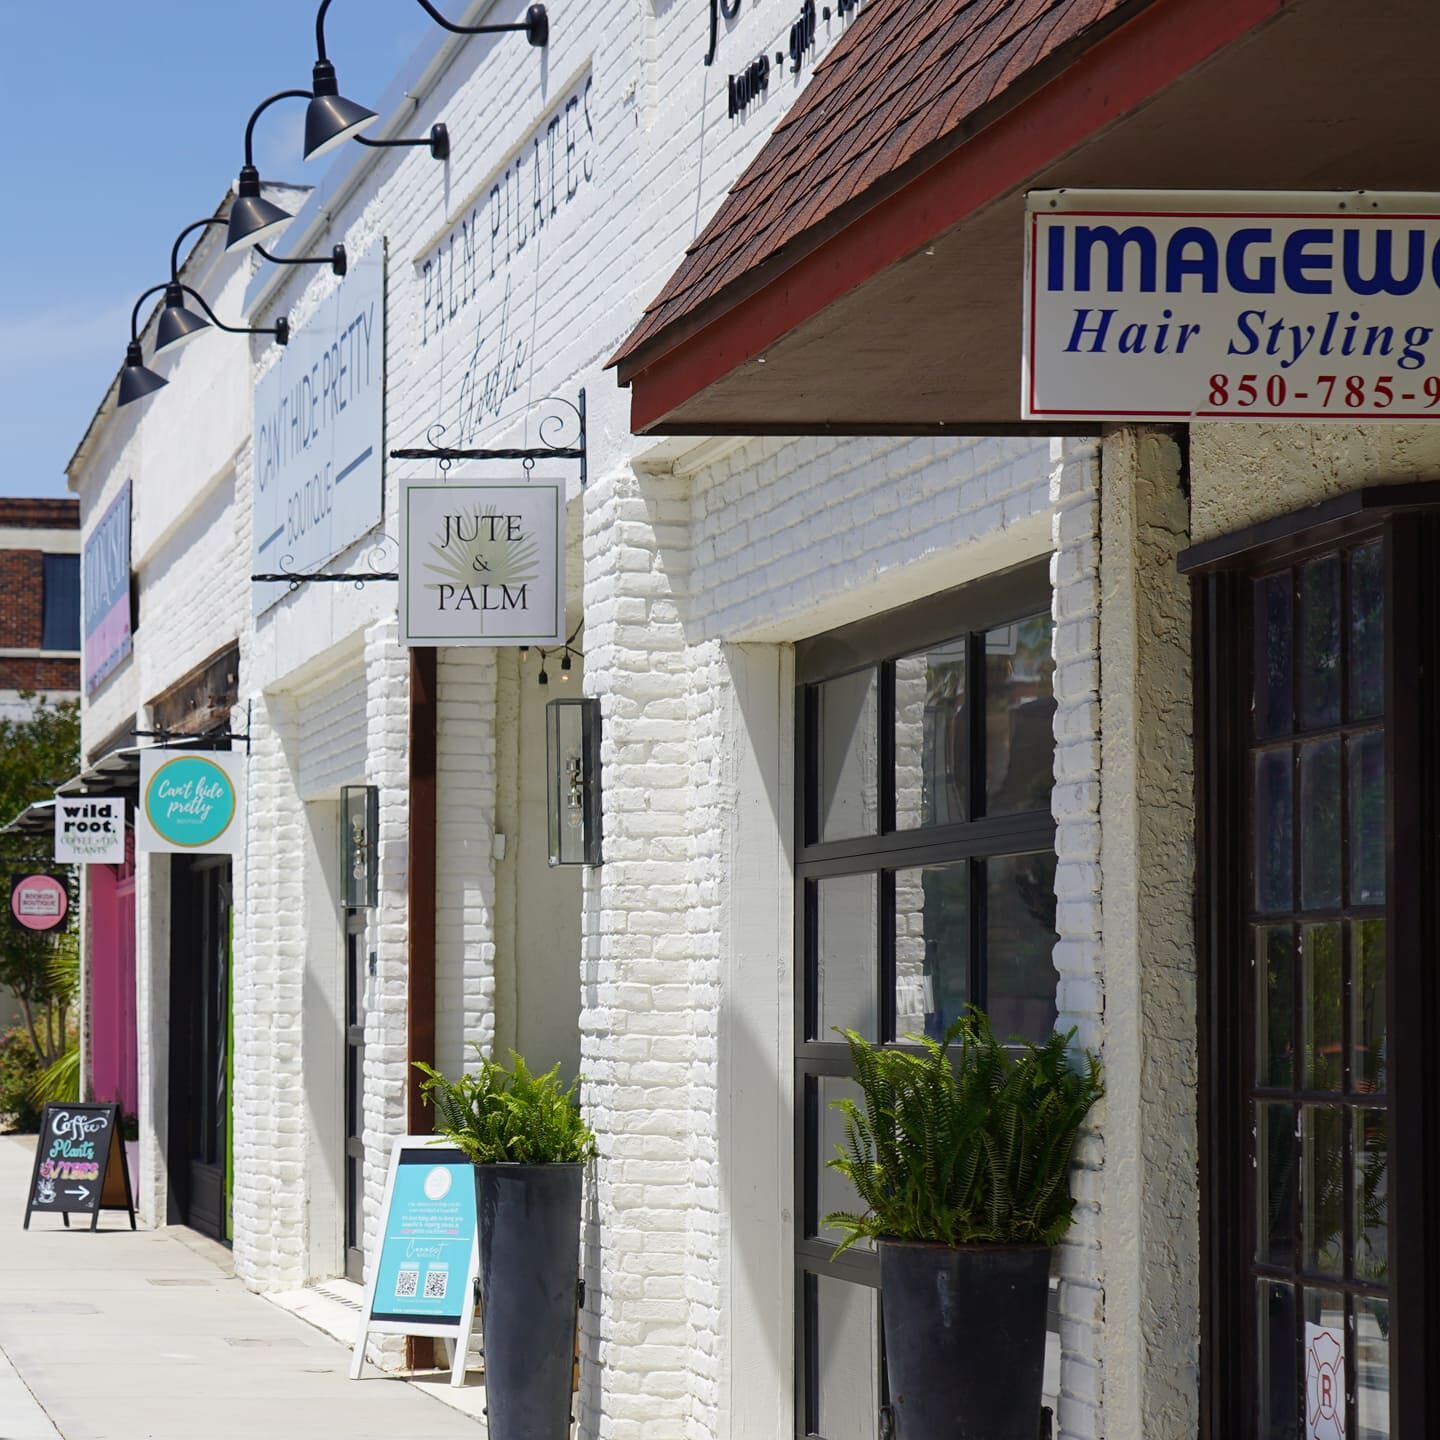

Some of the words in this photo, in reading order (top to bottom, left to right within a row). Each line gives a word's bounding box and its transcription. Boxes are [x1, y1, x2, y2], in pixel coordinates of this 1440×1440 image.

[422, 209, 477, 347] PALM
[489, 75, 593, 281] PILATES
[1047, 225, 1440, 296] IMAGEW
[1062, 308, 1201, 354] Hair
[1226, 310, 1433, 370] Styling
[291, 362, 319, 460] HIDE
[323, 301, 374, 428] PRETTY
[1208, 373, 1440, 409] 850-785-9
[288, 461, 332, 546] BOUTIQUE
[441, 514, 523, 548] JUTE
[472, 554, 491, 572] &
[437, 583, 529, 611] PALM
[158, 779, 192, 799] Can't
[195, 776, 224, 799] hide
[63, 804, 118, 818] wild.
[166, 796, 213, 820] pretty
[64, 820, 116, 833] root.
[52, 1112, 107, 1140] Coffee
[49, 1139, 94, 1160] Plants
[1322, 1374, 1332, 1408] R
